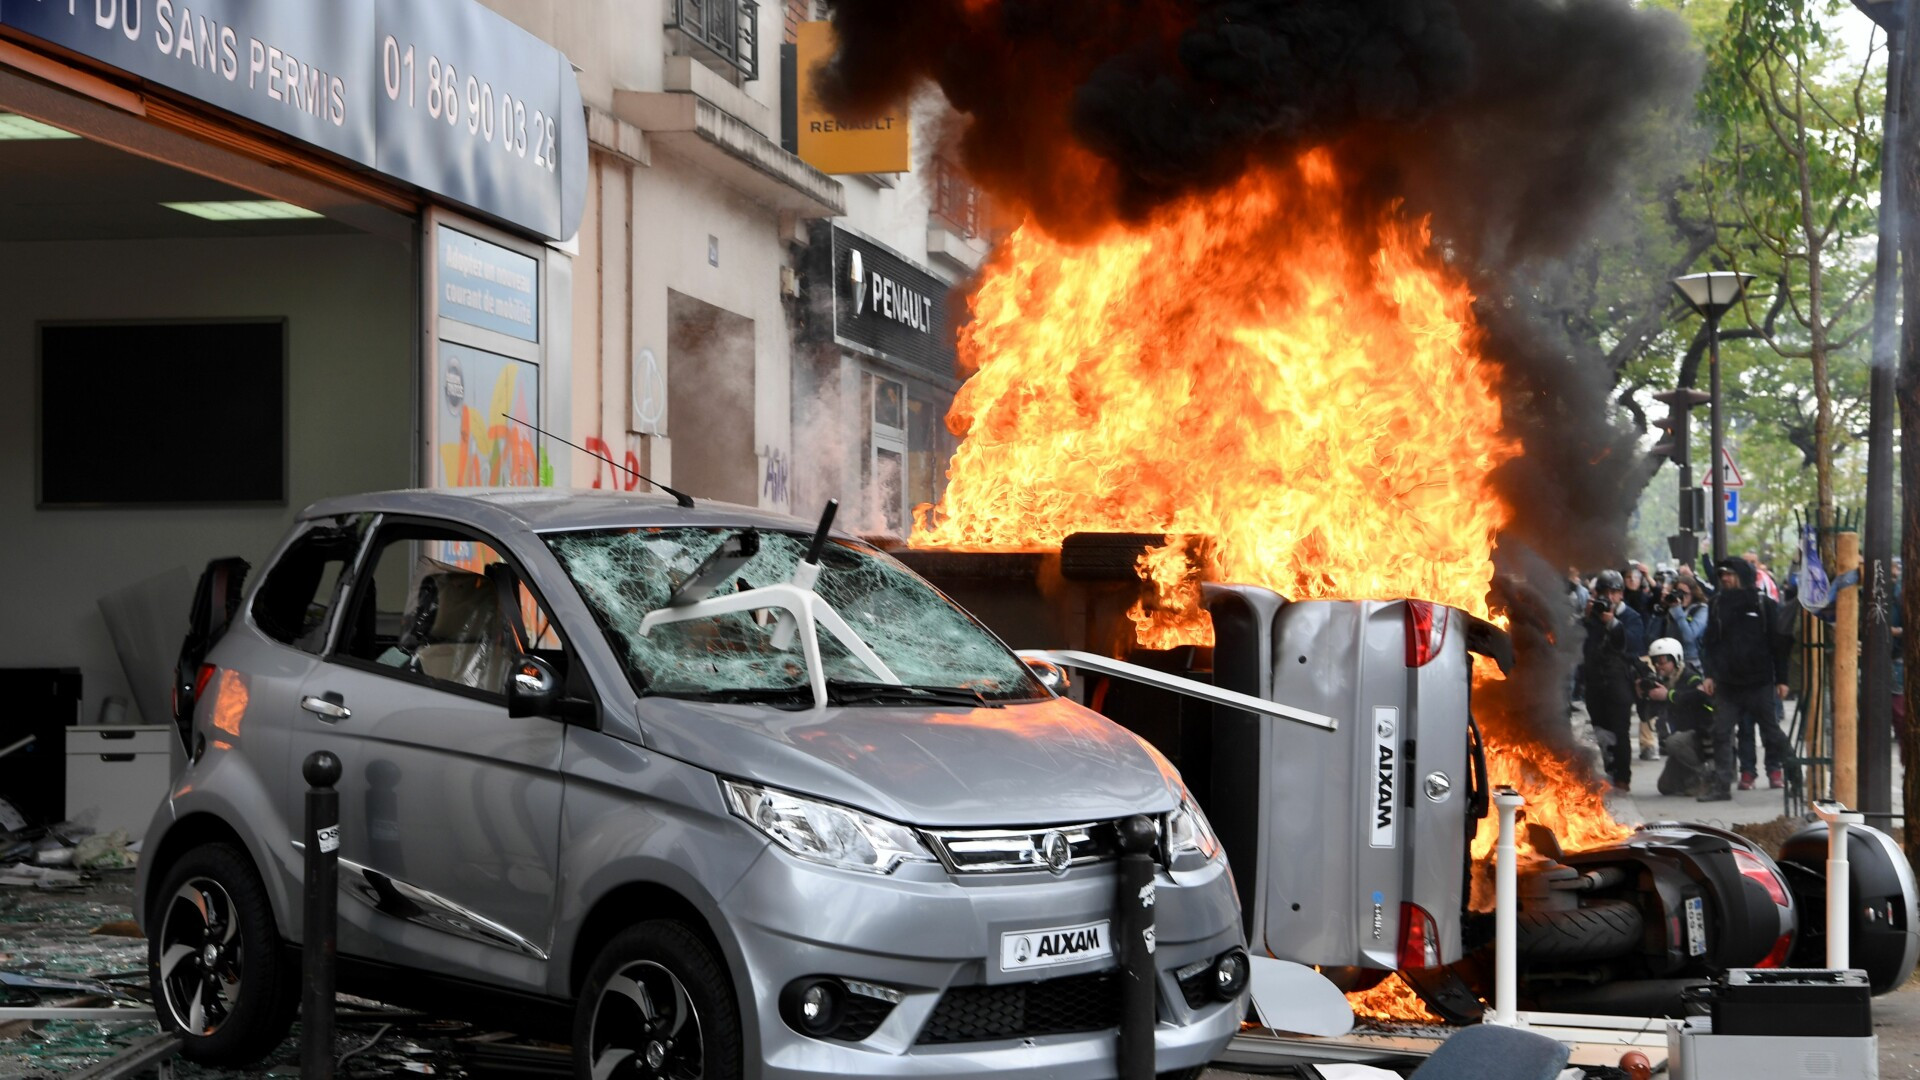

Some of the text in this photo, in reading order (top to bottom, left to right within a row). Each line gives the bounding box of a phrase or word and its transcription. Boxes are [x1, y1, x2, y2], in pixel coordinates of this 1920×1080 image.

[155, 0, 238, 82] SANS
[248, 39, 346, 127] PERMIS
[383, 34, 557, 174] 01 86 90 03 28
[1376, 744, 1394, 830] AIXAM
[1036, 928, 1100, 957] AIXAM
